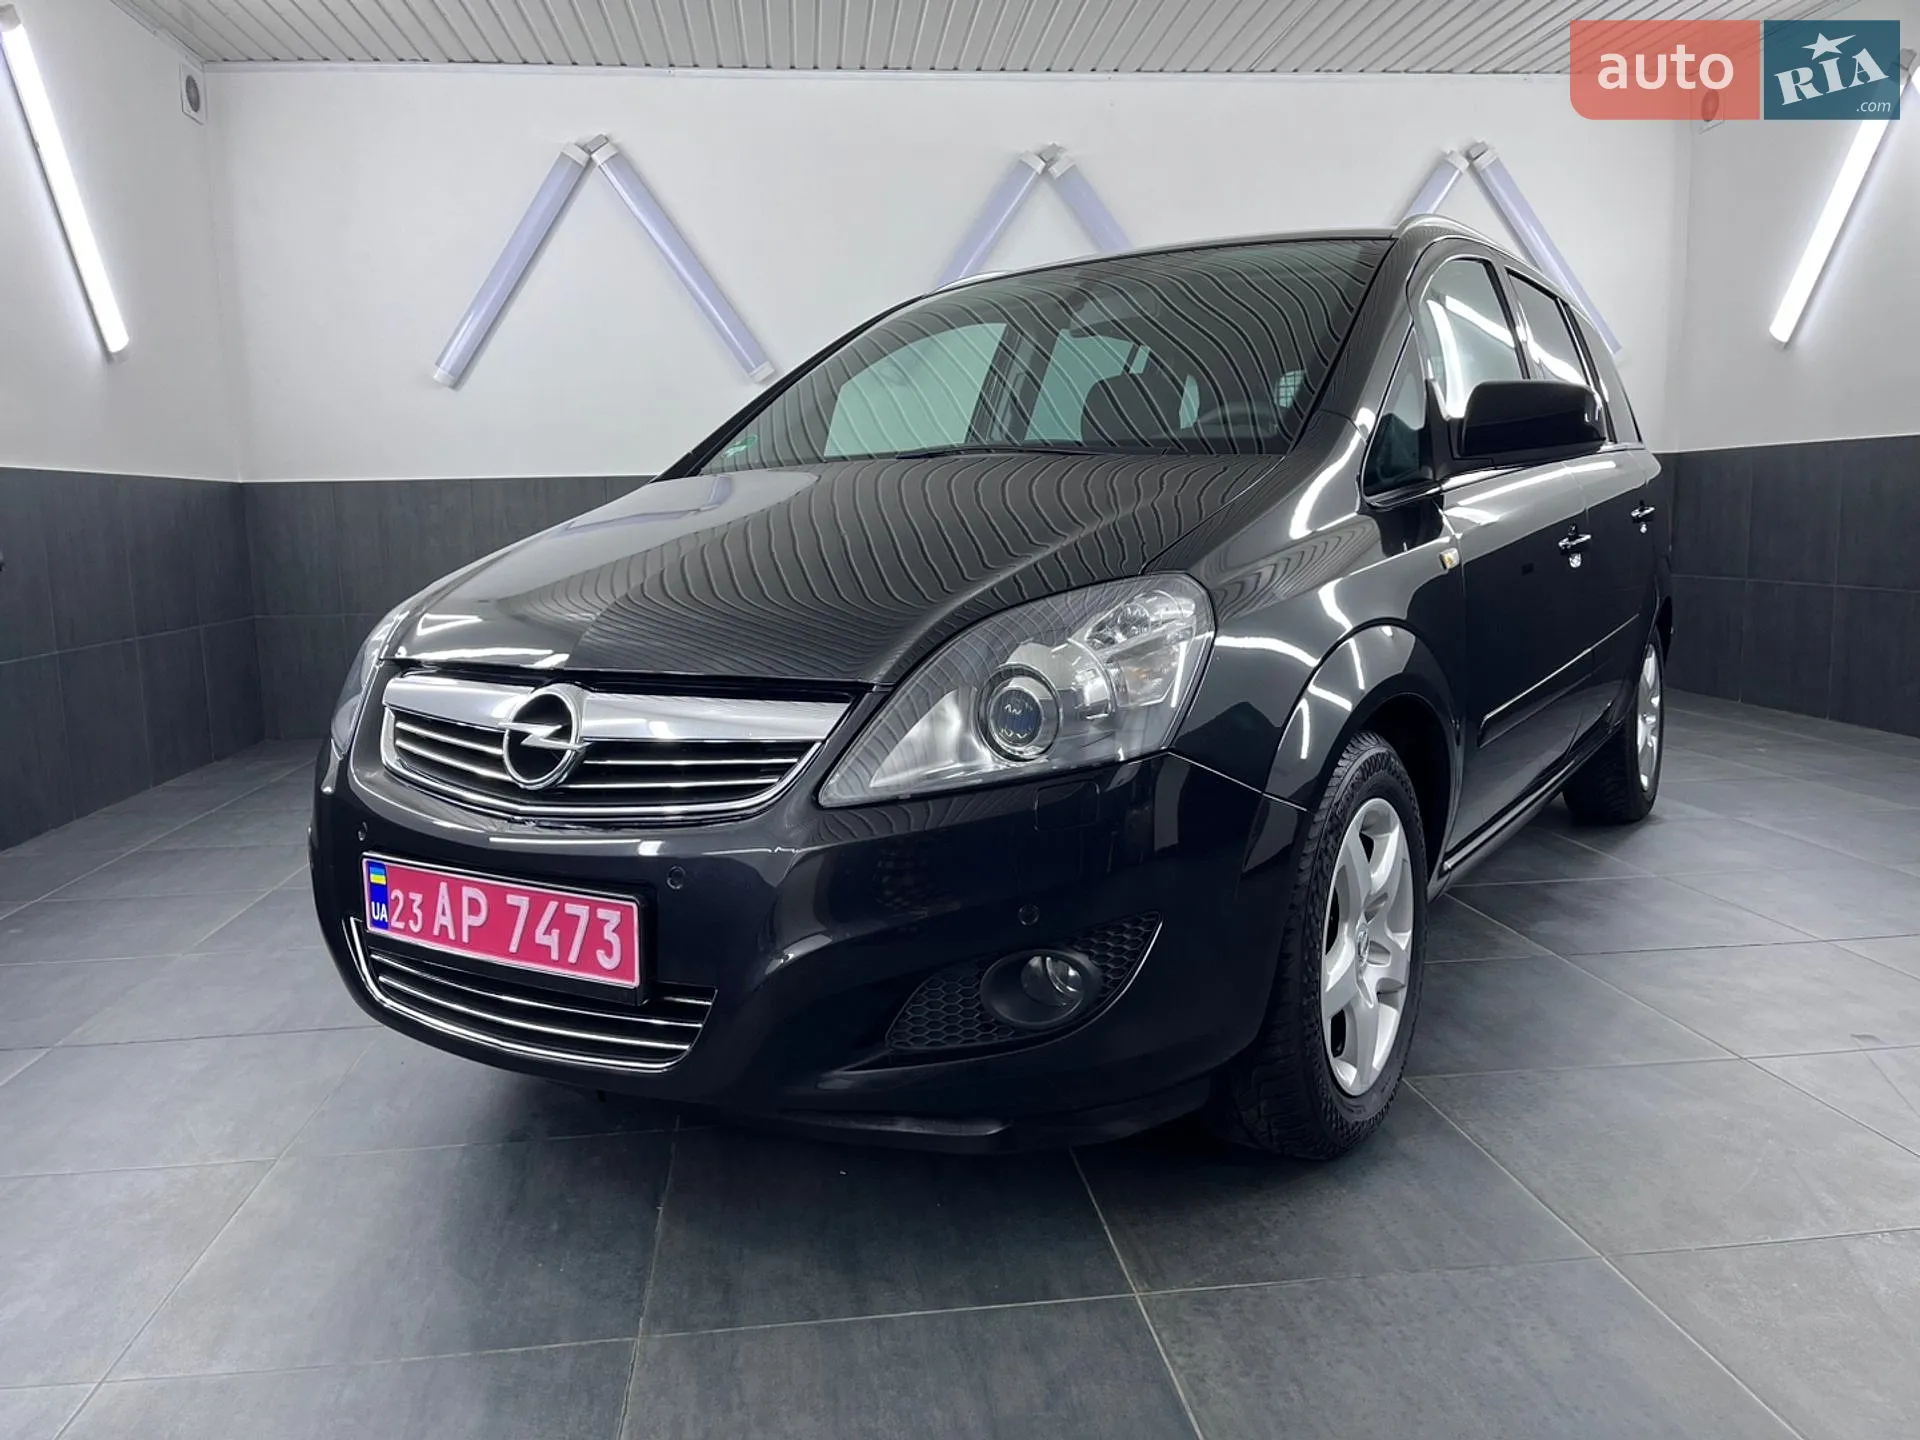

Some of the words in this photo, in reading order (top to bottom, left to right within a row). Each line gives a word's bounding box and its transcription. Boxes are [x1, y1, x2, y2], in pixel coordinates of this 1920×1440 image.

[371, 901, 388, 923] UA
[390, 889, 423, 933] 23
[432, 881, 488, 943] AP
[505, 894, 622, 971] 7473
